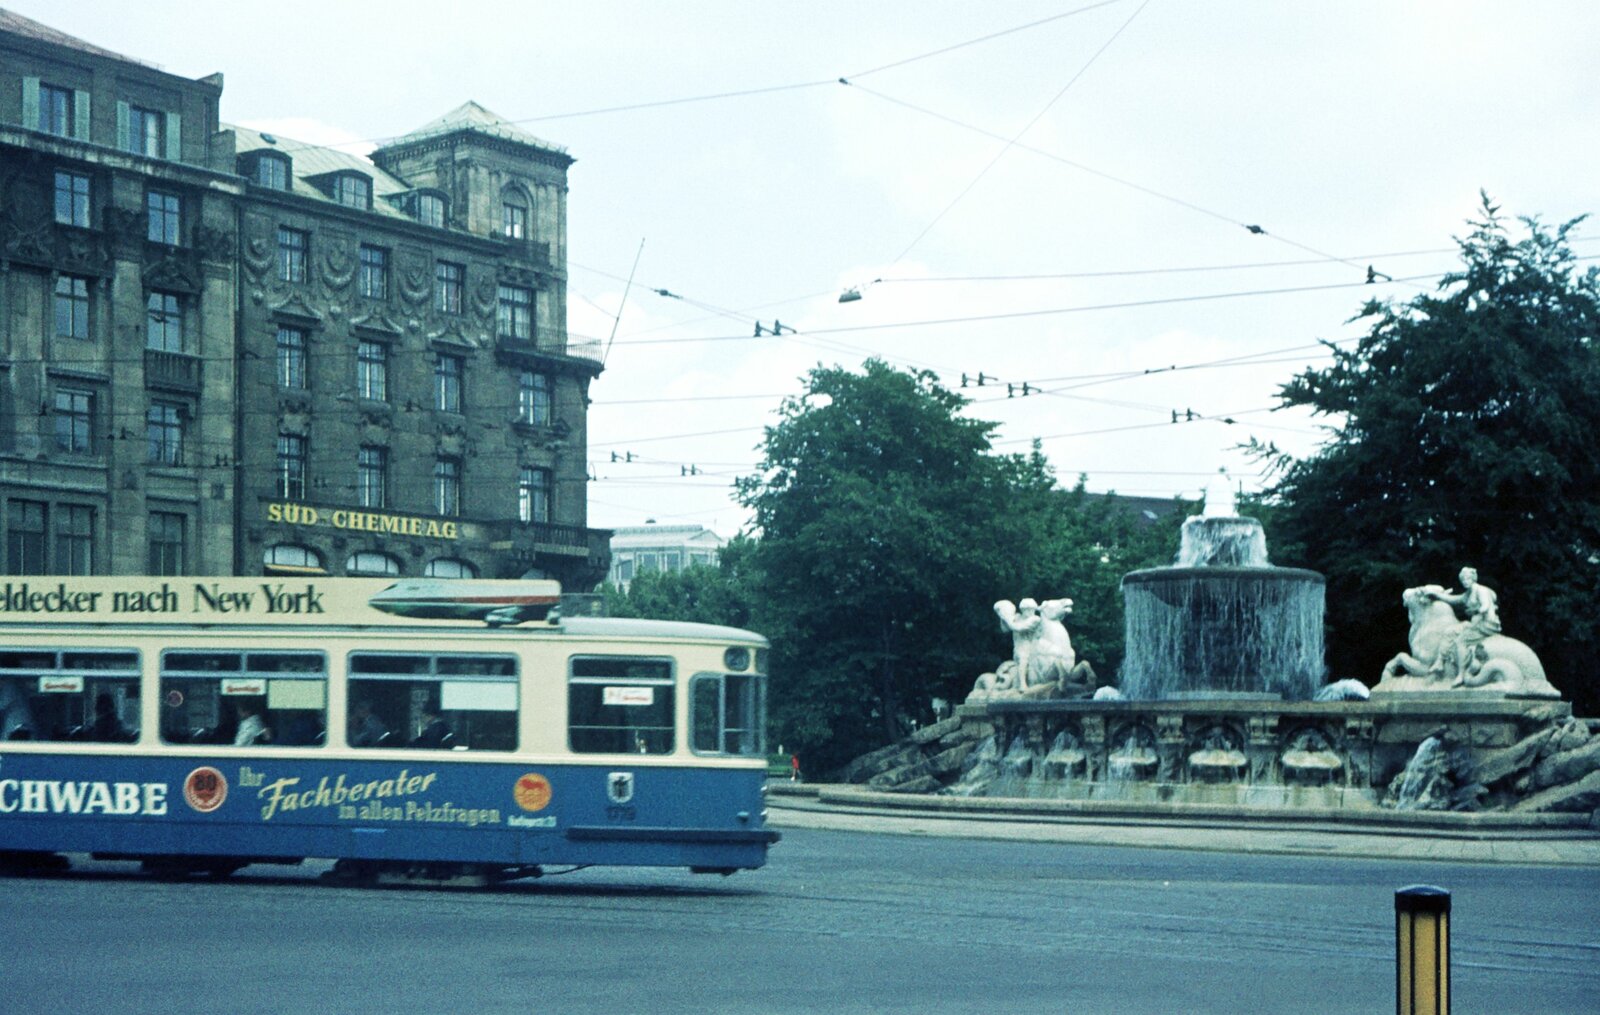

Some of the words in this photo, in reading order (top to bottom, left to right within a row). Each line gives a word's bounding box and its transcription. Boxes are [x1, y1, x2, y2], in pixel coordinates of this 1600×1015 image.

[332, 509, 423, 536] CHEMIE
[111, 583, 178, 613] nach
[193, 583, 254, 613] New
[260, 583, 325, 614] York
[0, 779, 168, 815] CHWABE
[257, 769, 436, 821] Fachberater
[339, 803, 357, 820] in
[360, 800, 403, 821] allen
[405, 800, 501, 827] Pelzfragen
